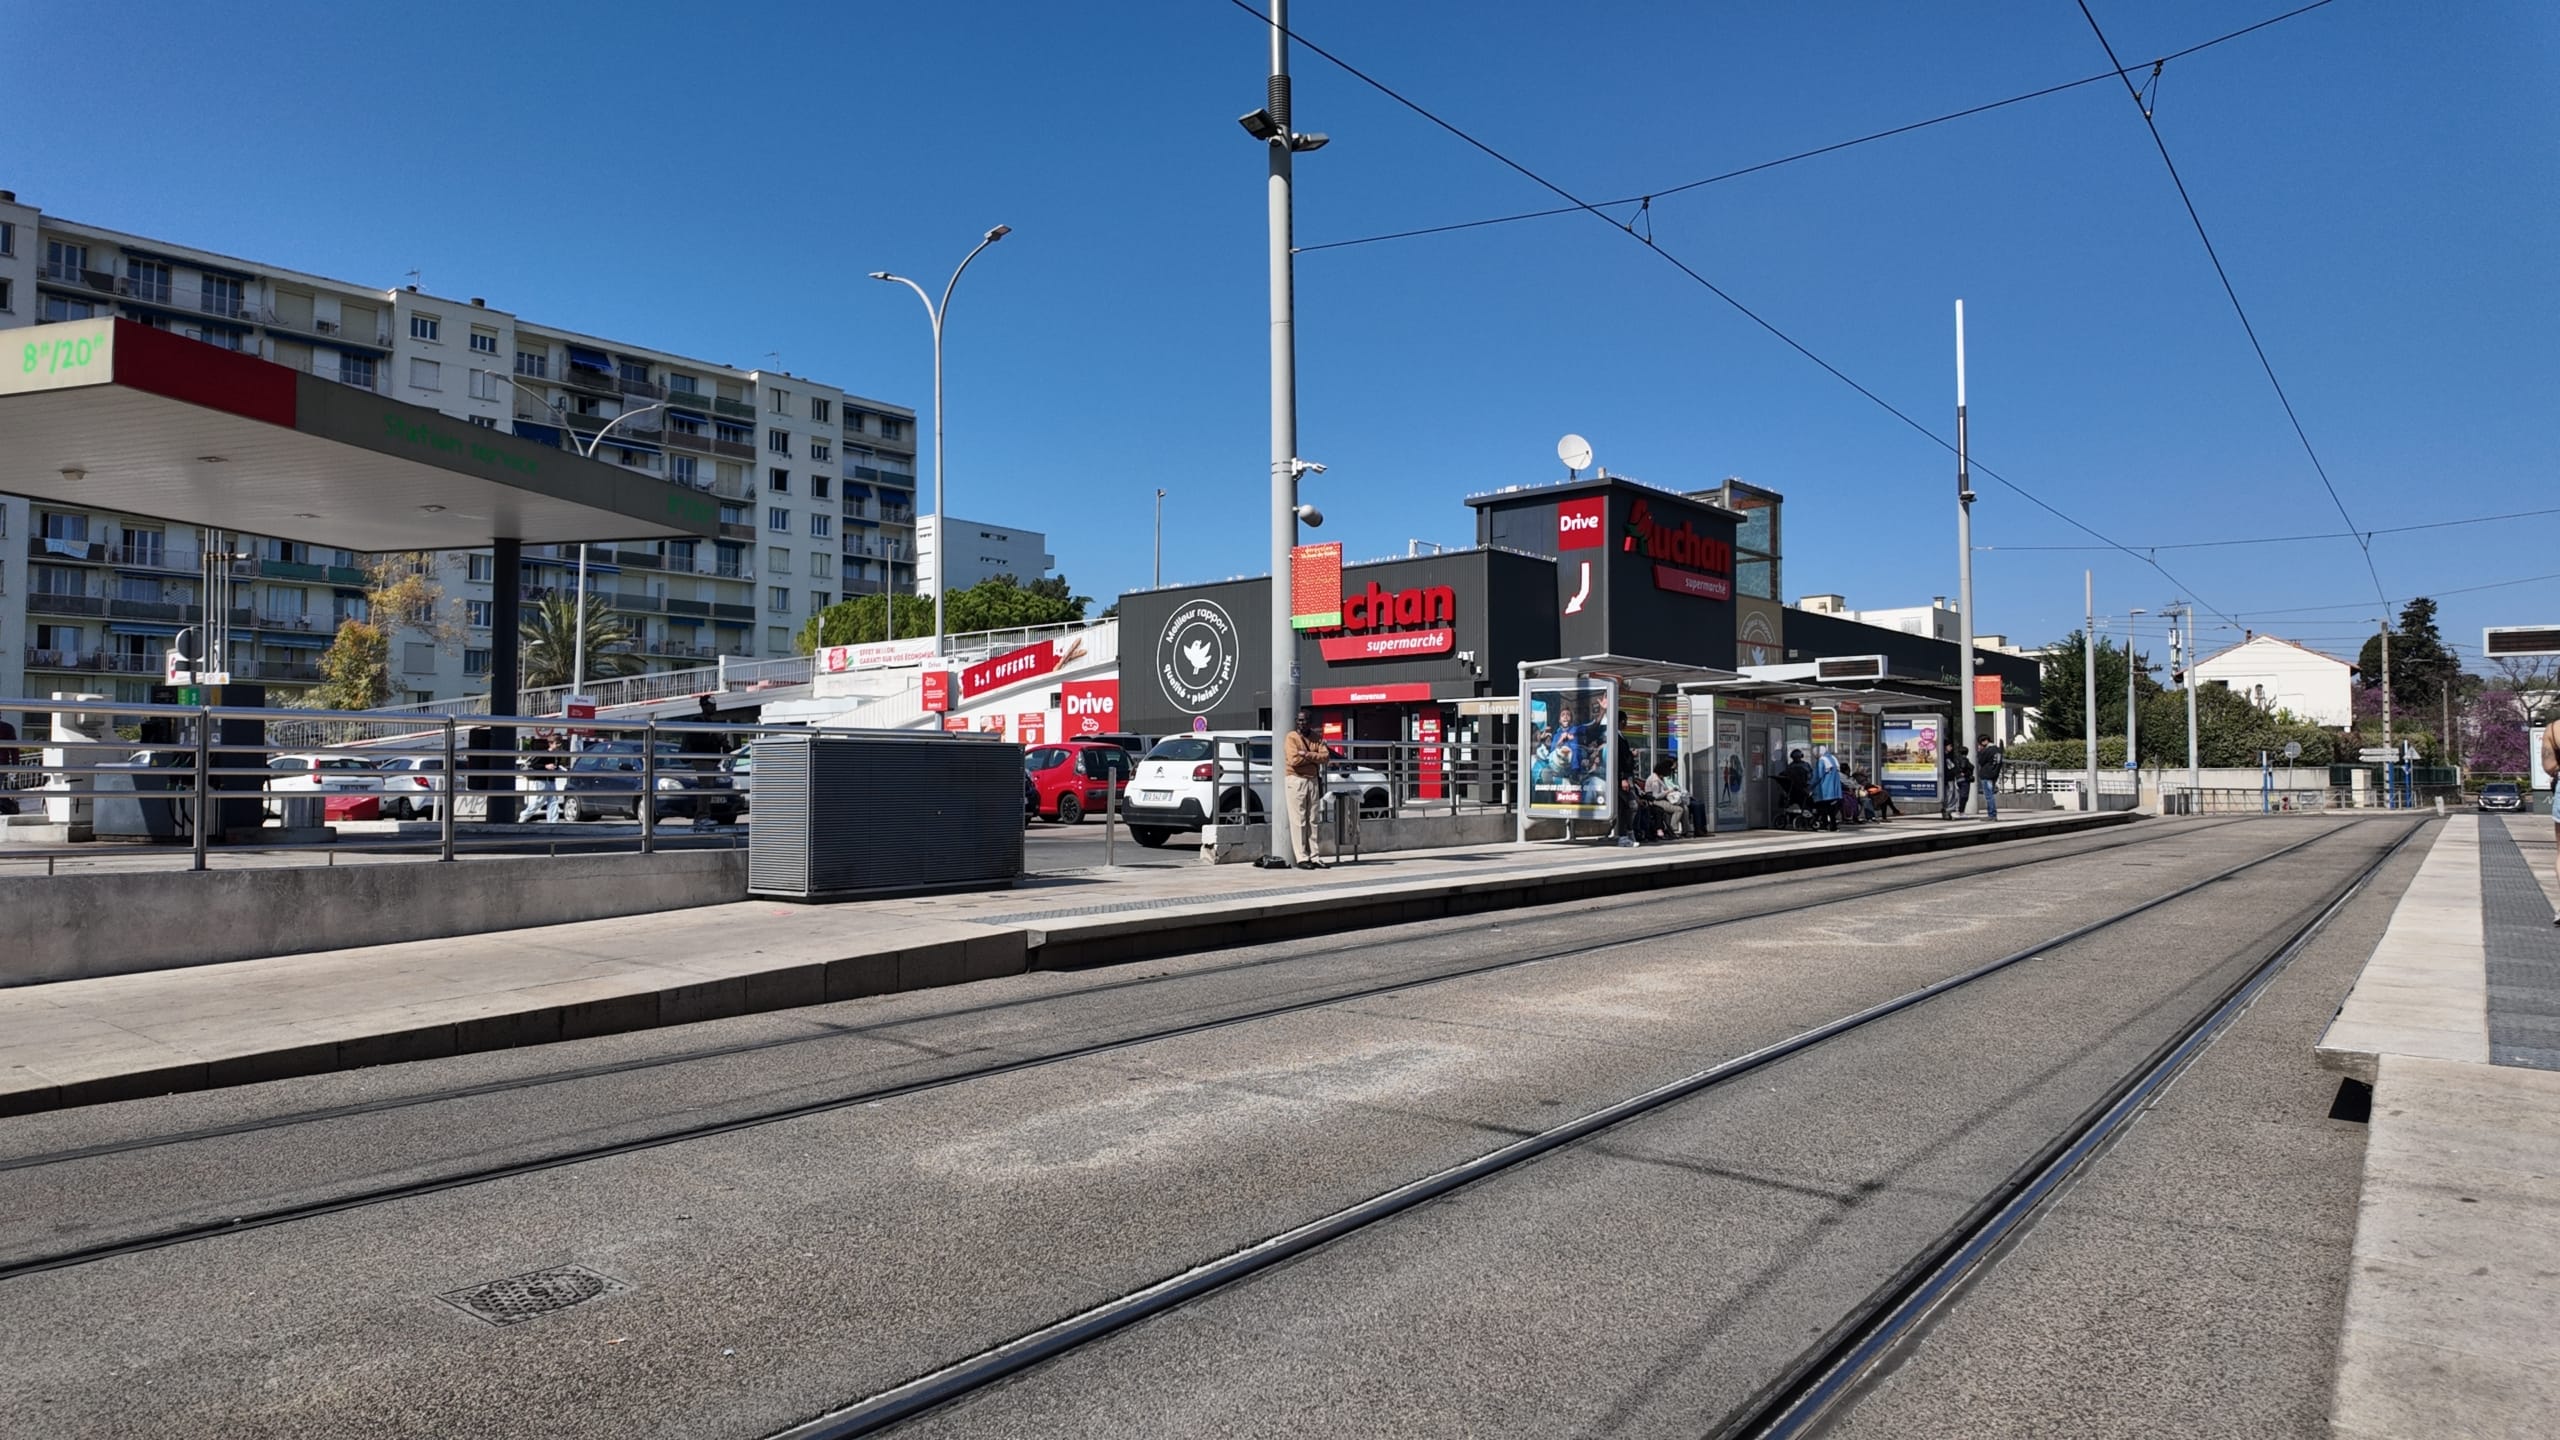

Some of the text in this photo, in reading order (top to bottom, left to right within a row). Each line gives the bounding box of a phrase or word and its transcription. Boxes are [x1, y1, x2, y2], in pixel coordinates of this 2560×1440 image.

[1560, 513, 1599, 532] Drive
[1623, 498, 1731, 574] Auchan
[1685, 576, 1727, 595] supermarché
[1165, 608, 1228, 643] Meilleur rapport
[1366, 633, 1444, 654] supermarché
[995, 653, 1036, 679] OFFERTE
[1163, 654, 1232, 705] qualité plaisir prix
[1067, 692, 1114, 715] Drive
[1350, 691, 1387, 702] Bienvenue
